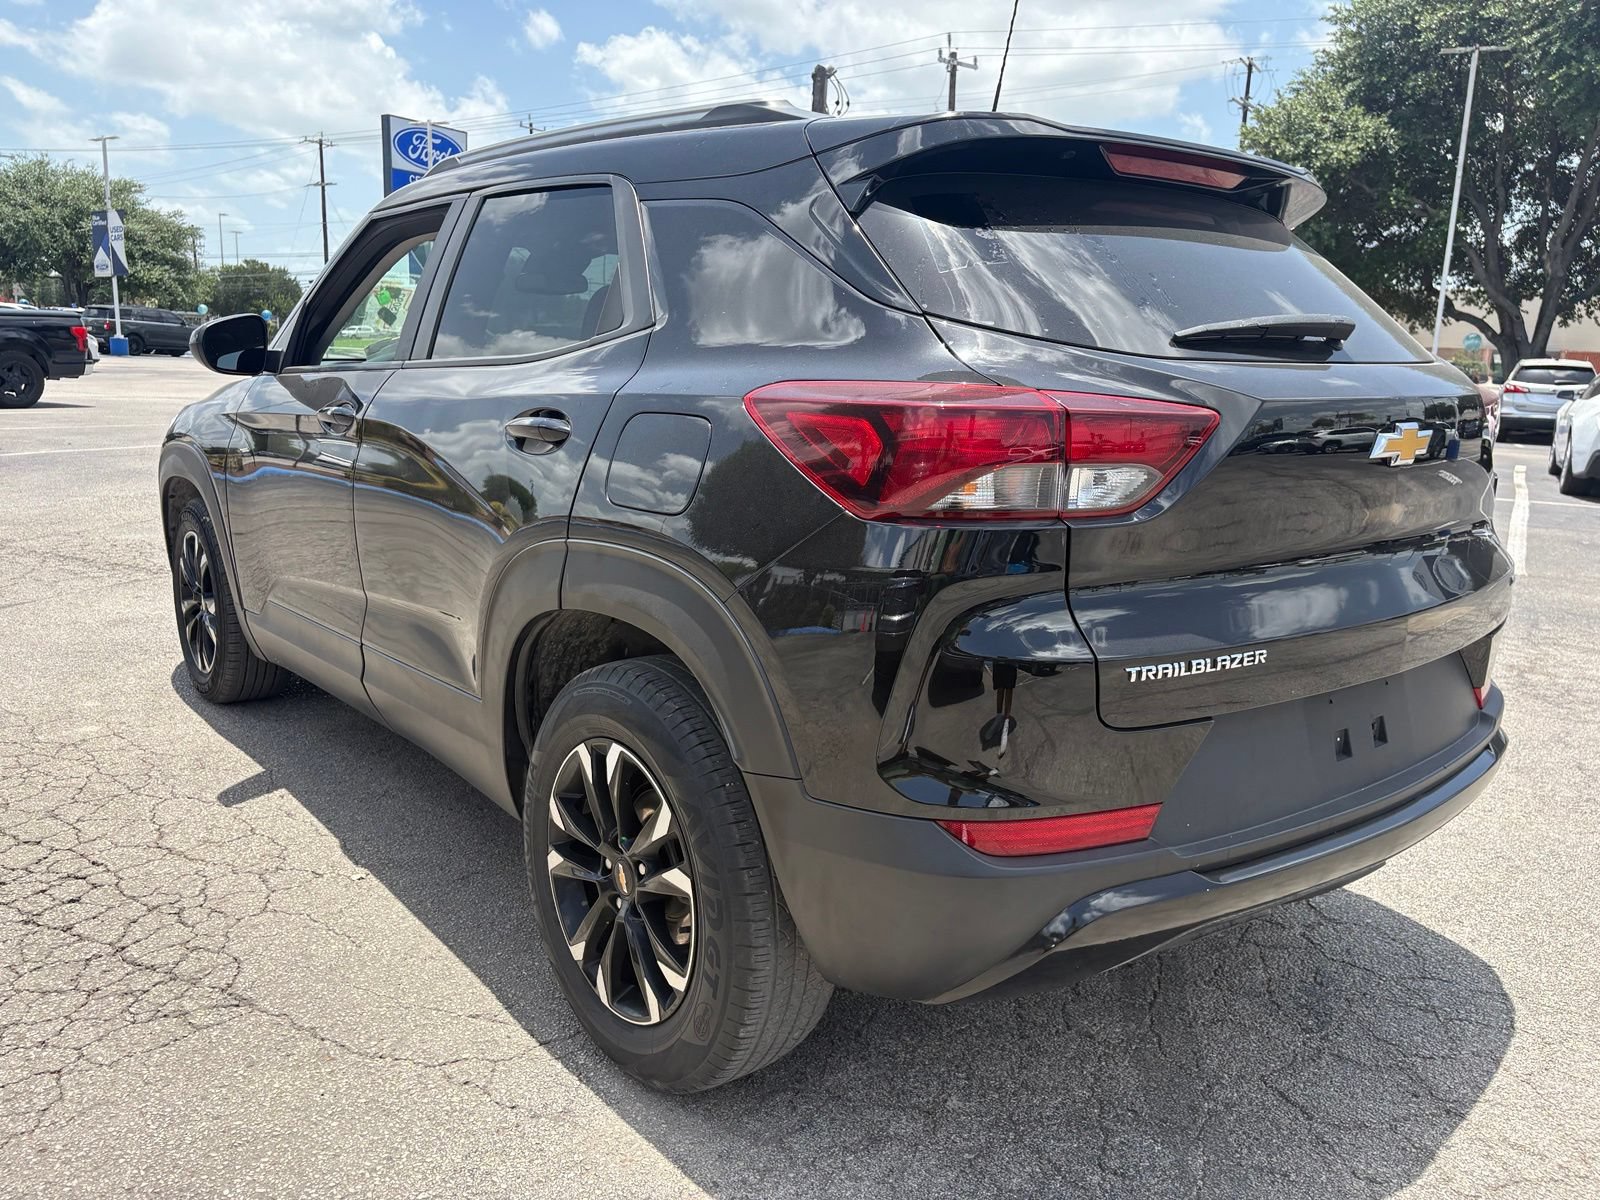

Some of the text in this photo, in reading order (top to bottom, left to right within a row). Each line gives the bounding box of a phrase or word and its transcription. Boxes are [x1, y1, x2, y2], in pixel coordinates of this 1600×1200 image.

[408, 133, 452, 162] Ford
[110, 225, 124, 233] USED
[1124, 649, 1268, 683] TRAILBLAZER
[704, 935, 721, 1001] GT
